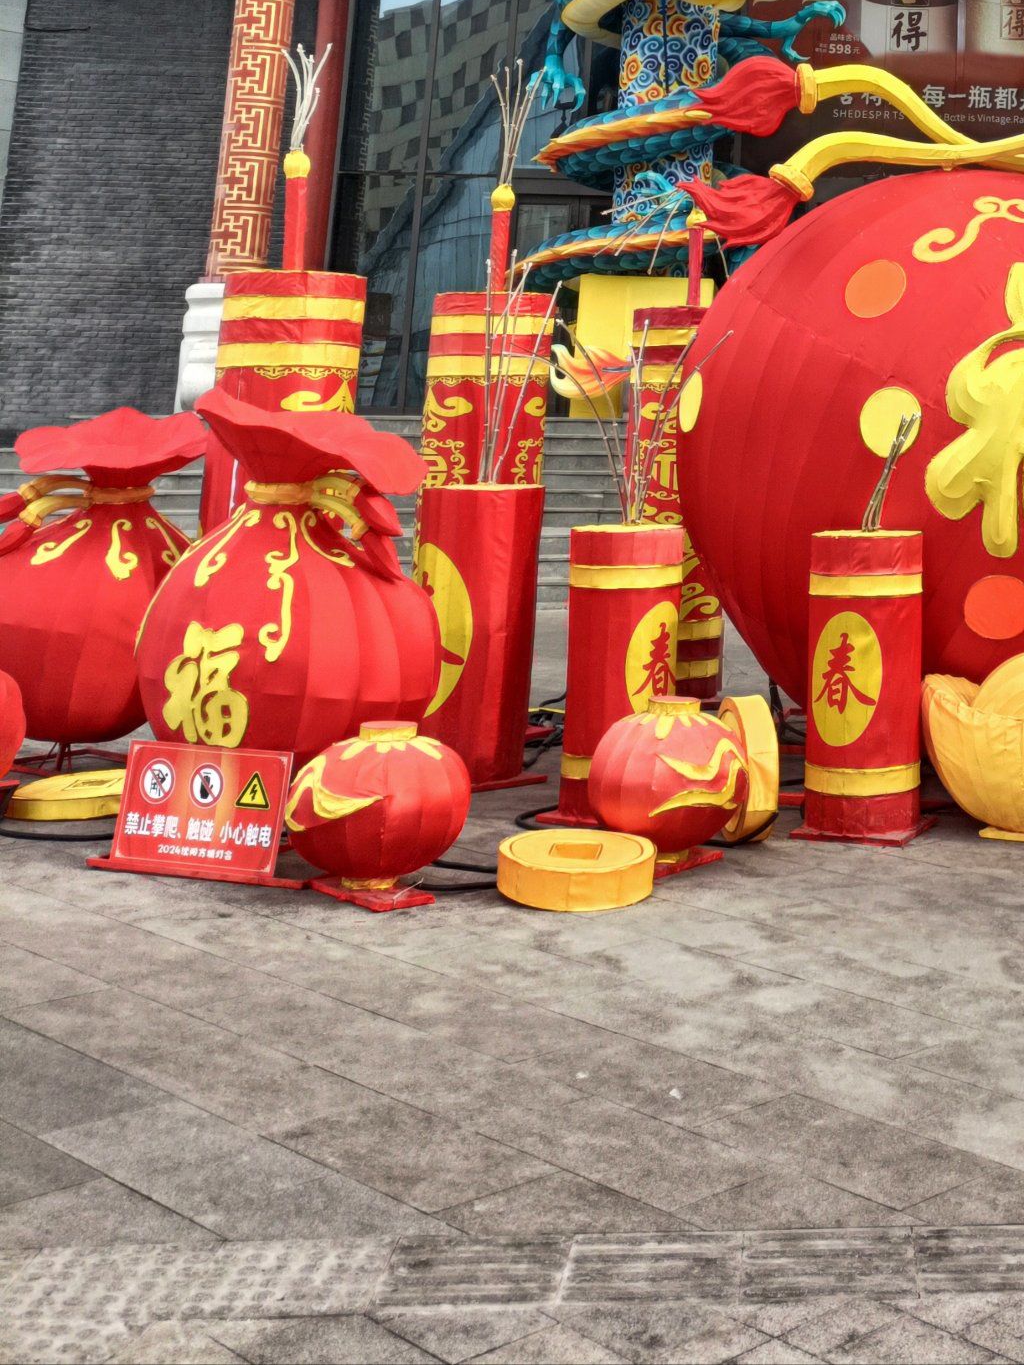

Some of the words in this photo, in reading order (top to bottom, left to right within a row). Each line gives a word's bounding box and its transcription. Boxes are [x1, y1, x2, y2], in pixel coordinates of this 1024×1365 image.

[163, 621, 250, 748] 福
[631, 621, 677, 697] 春
[814, 632, 876, 715] 春
